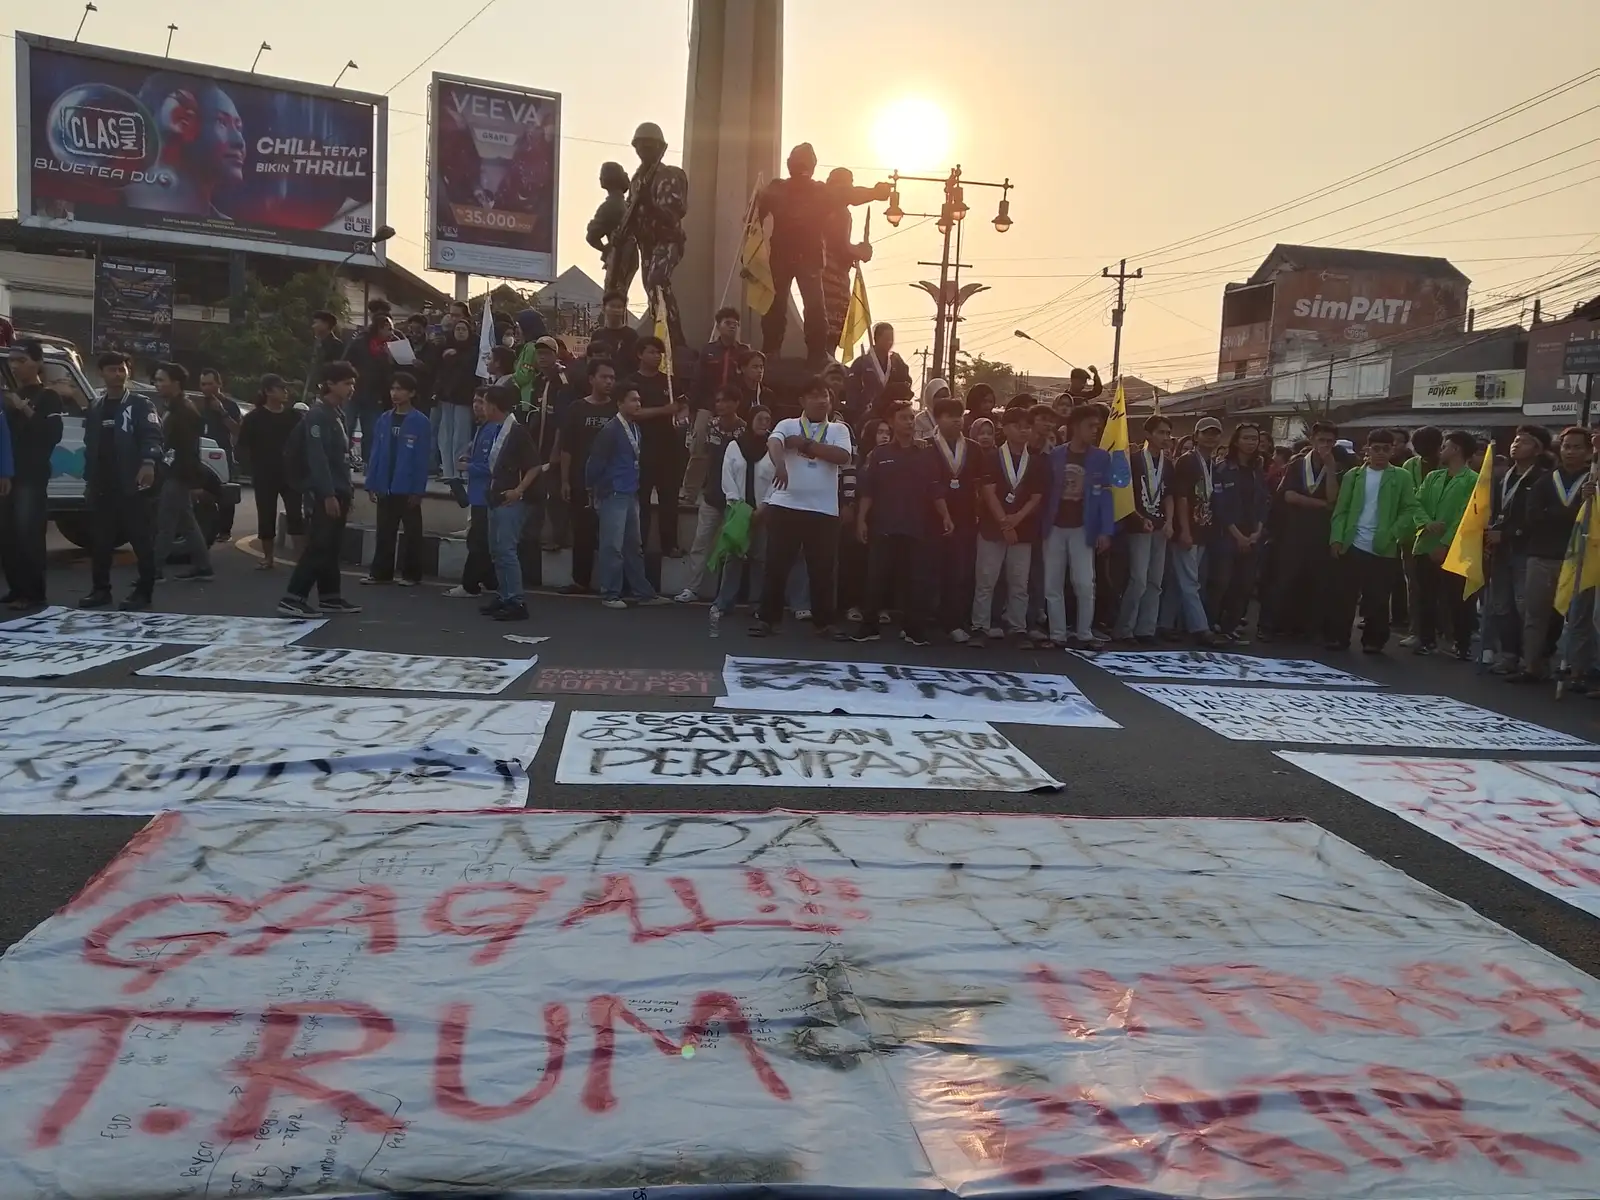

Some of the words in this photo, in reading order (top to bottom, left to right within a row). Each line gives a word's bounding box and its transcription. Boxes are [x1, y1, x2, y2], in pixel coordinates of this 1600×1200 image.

[451, 89, 541, 126] VEEVA
[71, 116, 120, 150] CLAS
[119, 117, 138, 150] MILD
[256, 136, 322, 157] CHILL
[322, 145, 368, 158] TETAP
[34, 158, 125, 180] BLUETEA
[256, 162, 290, 174] BIKIN
[293, 158, 366, 177] THRILL
[344, 222, 372, 233] GUE
[463, 209, 516, 229] 35.000
[1294, 293, 1413, 325] simPATI
[1427, 385, 1458, 398] POWER
[592, 712, 807, 729] SEGERA
[1195, 710, 1391, 729] RAKYAT
[645, 724, 893, 746] SAHKAN
[165, 812, 859, 886] PEMDA
